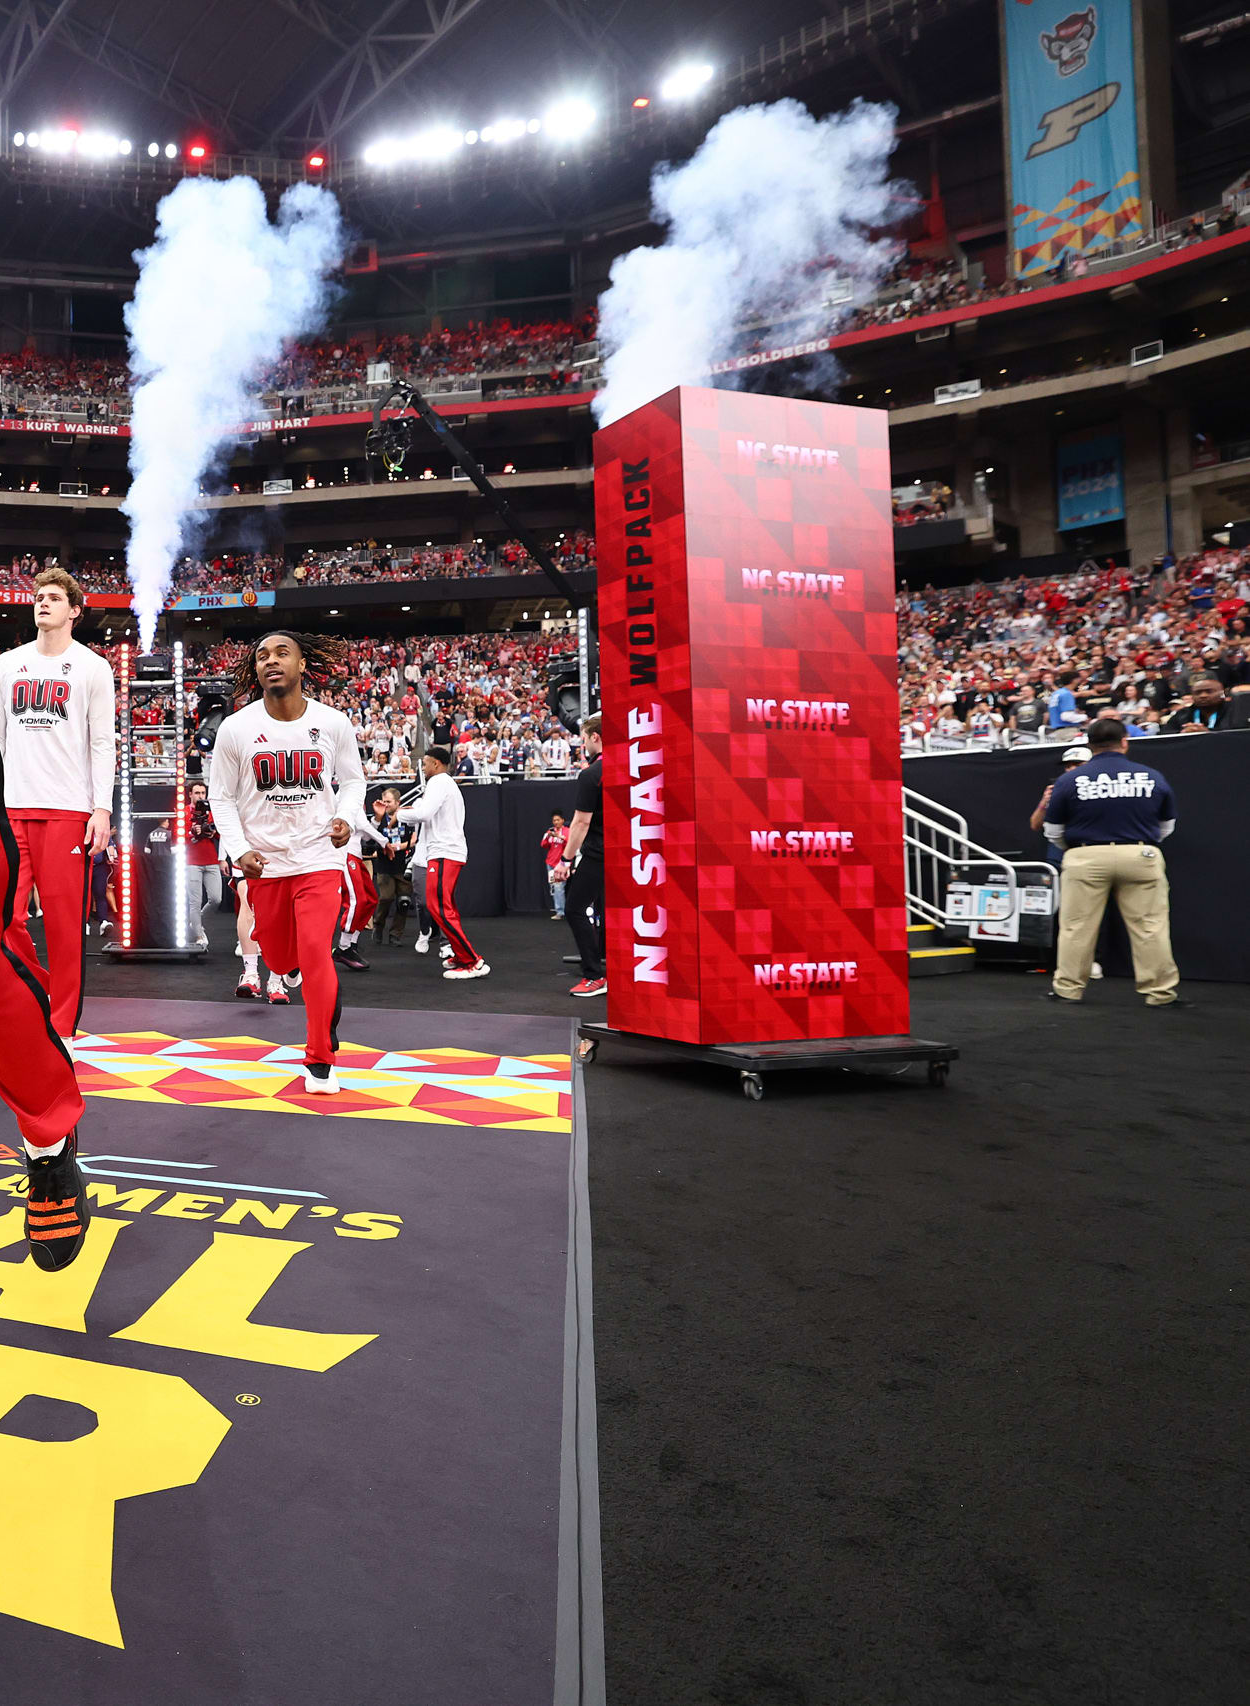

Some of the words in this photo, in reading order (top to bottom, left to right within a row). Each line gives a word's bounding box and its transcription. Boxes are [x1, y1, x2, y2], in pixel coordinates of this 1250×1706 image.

[737, 338, 830, 368] GOLDBERG
[10, 421, 23, 430] 13
[26, 421, 60, 432] KURT
[64, 423, 119, 435] WARNER
[251, 421, 271, 431] JIM
[274, 417, 311, 430] HART
[736, 439, 767, 461] NC
[771, 444, 840, 469] STATE
[622, 456, 658, 687] WOLFPACK
[741, 567, 773, 590] NC
[777, 570, 845, 596] STATE
[11, 679, 71, 720] OUR
[746, 698, 778, 722] NC
[781, 699, 851, 726] STATE
[18, 717, 60, 725] MOMENT
[251, 749, 325, 792] OUR
[265, 792, 317, 802] MOMENT
[628, 702, 667, 887] STATE
[1077, 783, 1155, 801] SECURITY
[750, 830, 782, 853] NC
[785, 831, 855, 853] STATE
[632, 904, 670, 985] NC
[754, 963, 785, 986] NC
[789, 961, 859, 985] STATE
[86, 1181, 404, 1241] MEN'S
